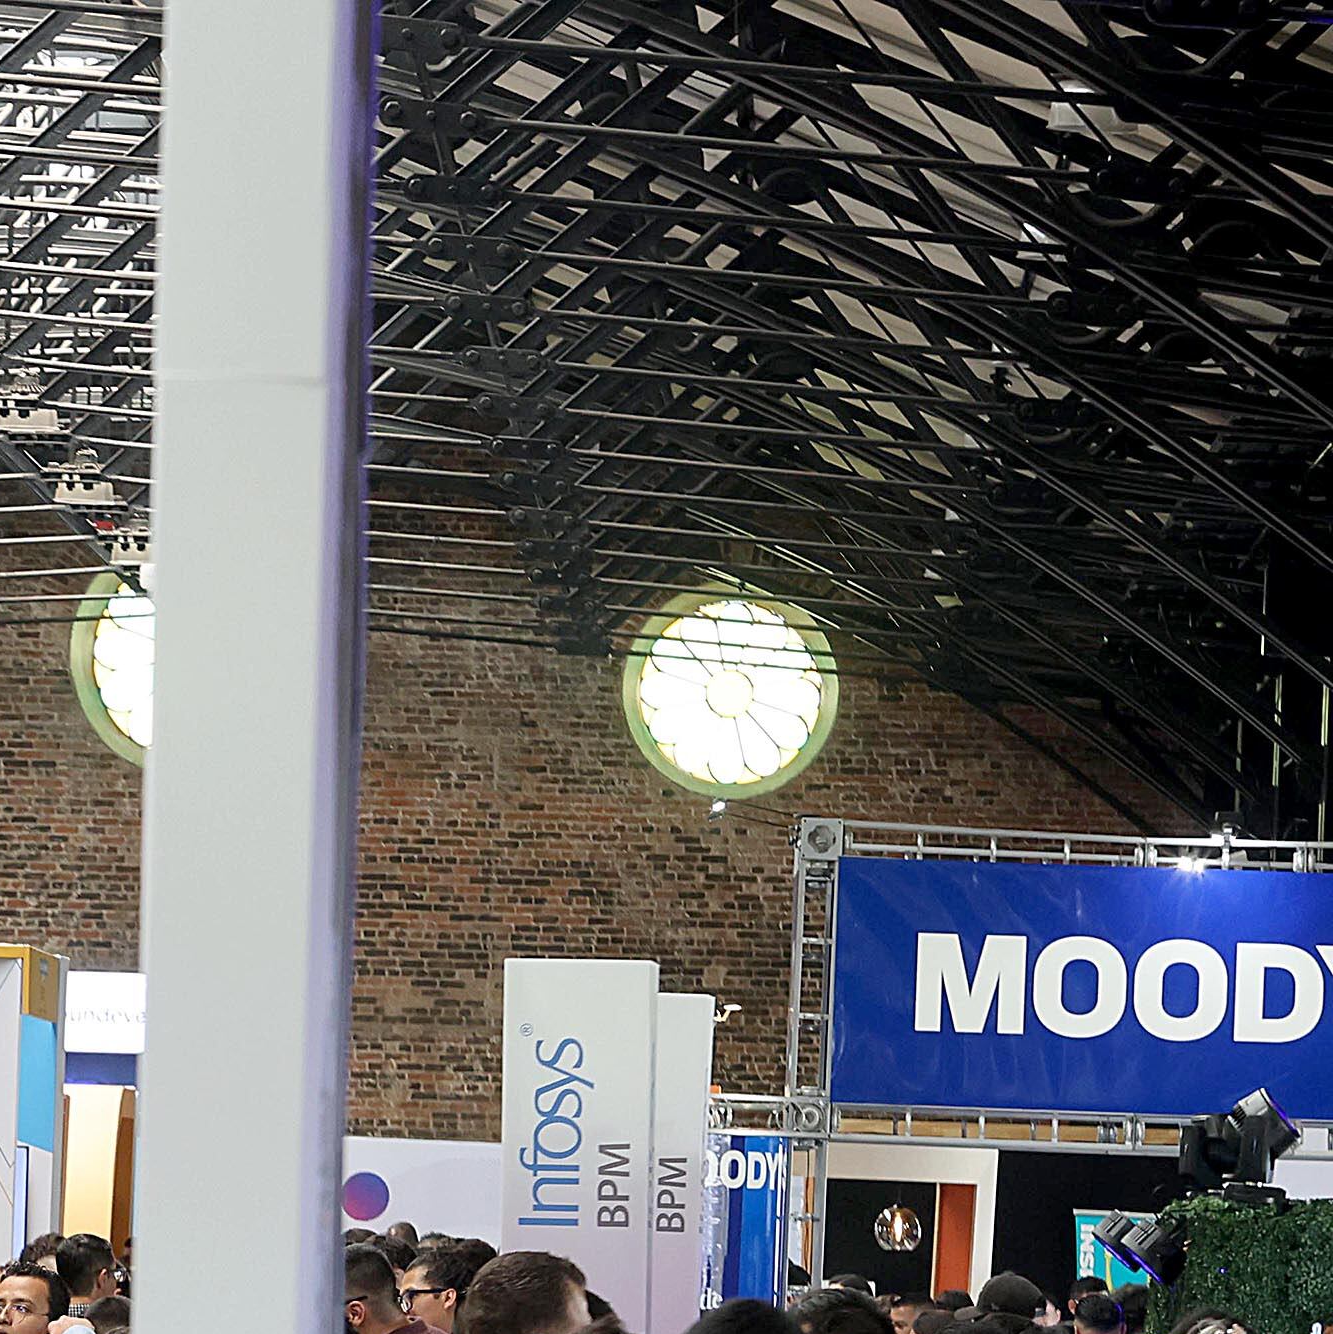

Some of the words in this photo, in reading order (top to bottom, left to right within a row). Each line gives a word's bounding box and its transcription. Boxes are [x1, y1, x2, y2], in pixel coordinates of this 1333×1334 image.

[915, 932, 1333, 1042] MOOD
[517, 1037, 595, 1227] Infosys
[597, 1143, 631, 1228] BPM
[656, 1157, 688, 1233] BPM
